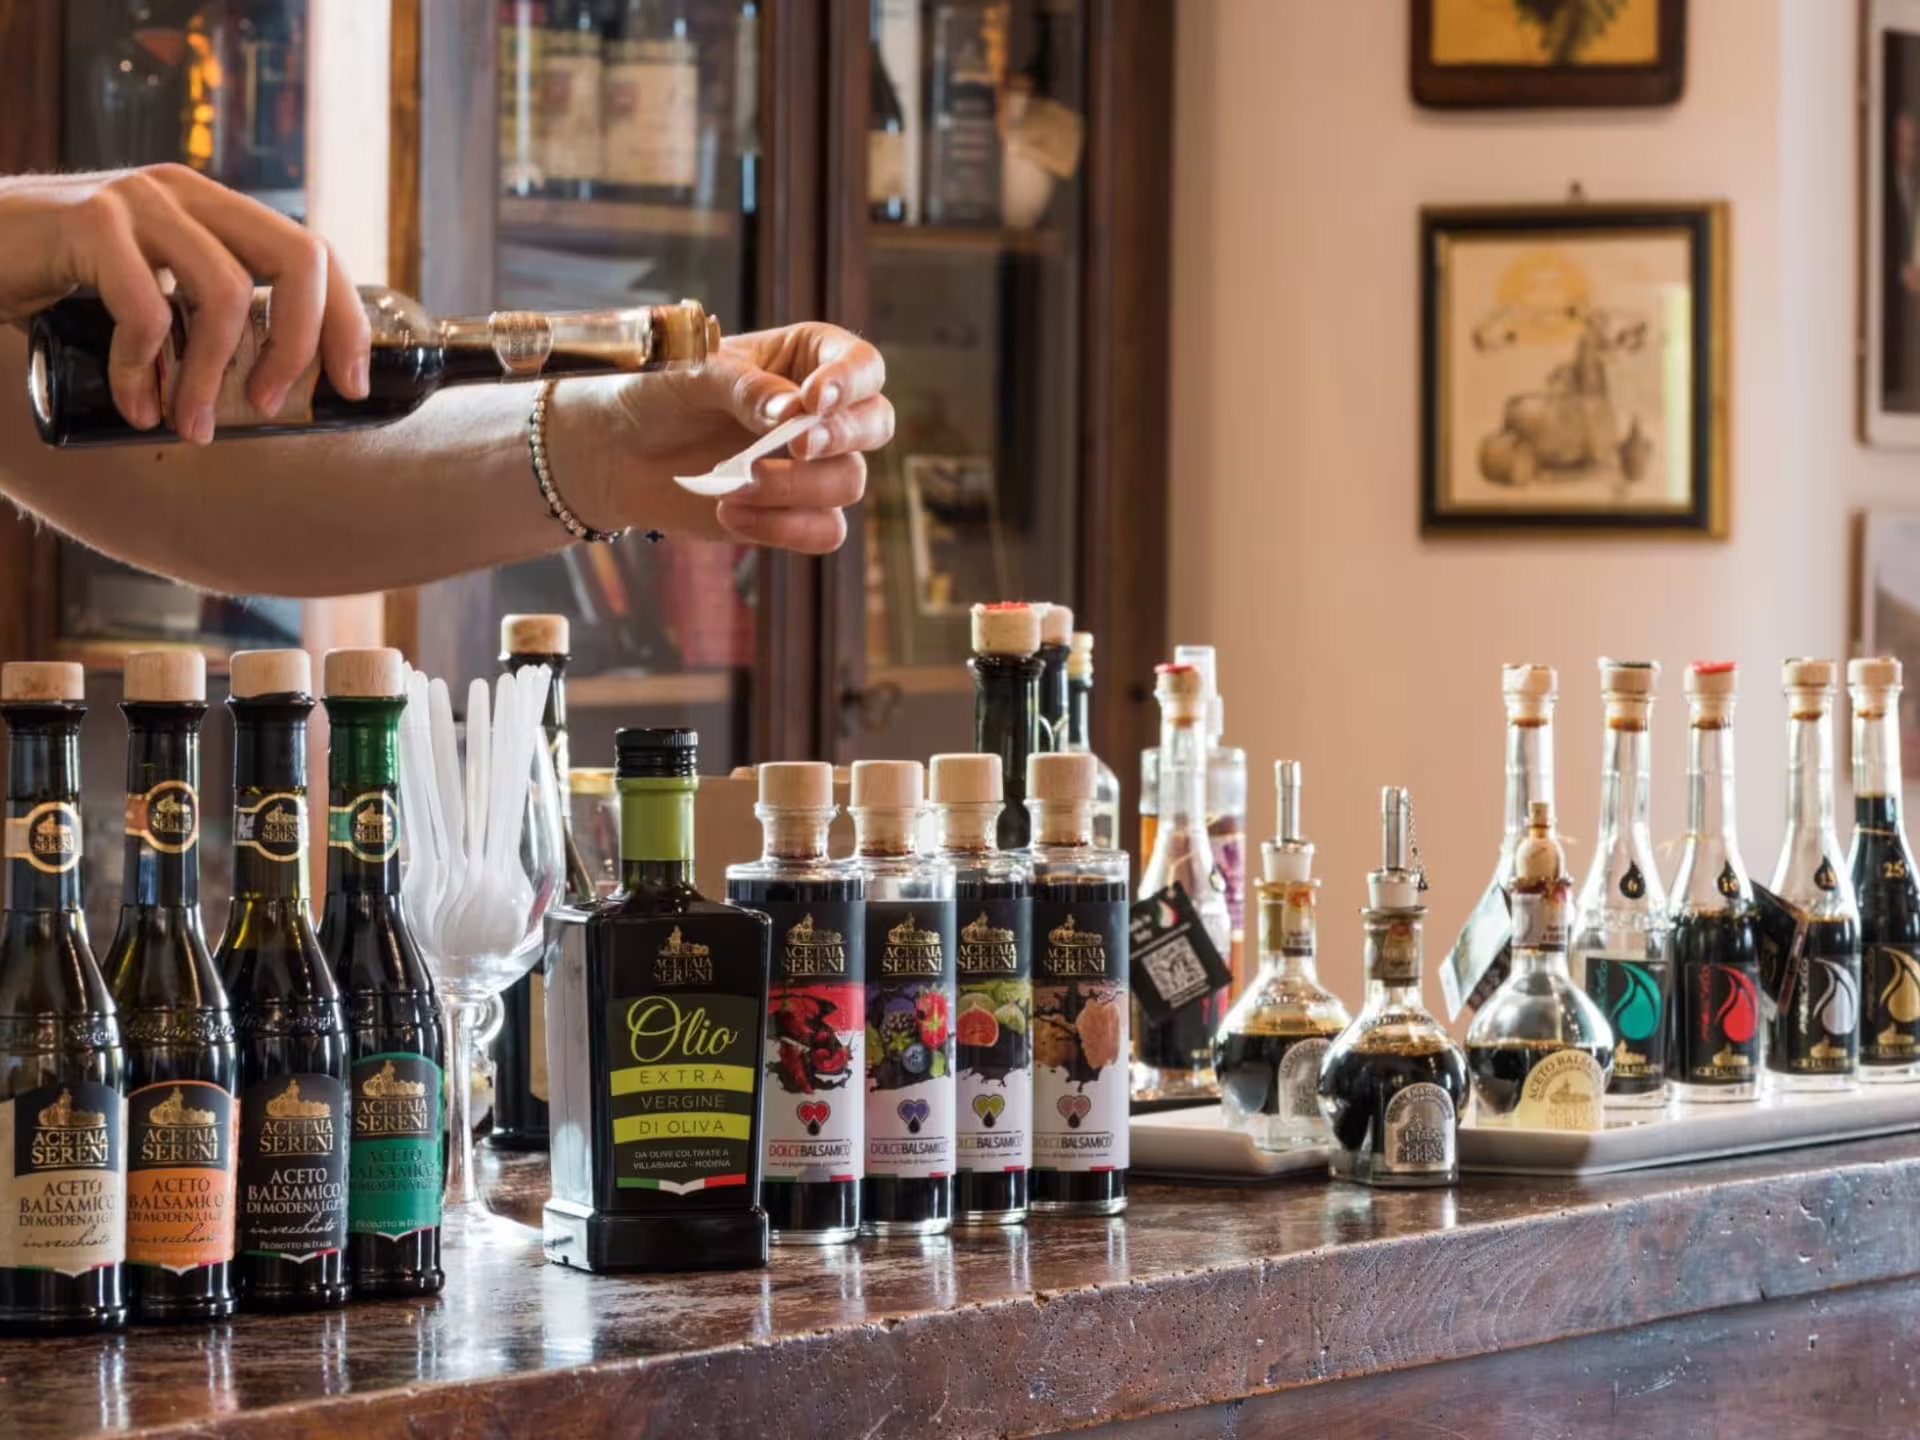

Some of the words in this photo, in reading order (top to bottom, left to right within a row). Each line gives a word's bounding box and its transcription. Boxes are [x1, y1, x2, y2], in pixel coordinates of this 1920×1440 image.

[1884, 863, 1905, 879] 25
[884, 945, 943, 958] ACETAIA
[960, 943, 1017, 957] ACETAIA
[783, 958, 845, 973] SERENI
[881, 958, 943, 973] SERENI
[957, 955, 1017, 970] SERENI
[1043, 958, 1106, 973] SERENI
[626, 995, 738, 1063] Olio
[639, 1068, 726, 1085] EXTRA
[1528, 1061, 1556, 1101] ACETO
[358, 1098, 428, 1114] ACETAIA
[641, 1094, 725, 1110] VERGINE
[261, 1119, 333, 1136] ACETAIA
[356, 1112, 429, 1131] SERENI
[639, 1120, 659, 1136] DI
[667, 1118, 725, 1136] OLIVA
[32, 1130, 108, 1146] ACETAIA
[144, 1128, 218, 1144] ACETAIA
[259, 1134, 334, 1153] SERENI
[31, 1144, 109, 1164] SERENI
[142, 1142, 218, 1161] SERENI
[650, 1149, 673, 1159] OLIVE
[675, 1148, 720, 1159] COLTIVATE
[769, 1143, 850, 1157] DOLCEBALSAMICO
[695, 1159, 731, 1169] MODENA
[270, 1166, 328, 1185] ACETO
[42, 1178, 102, 1196] ACETO
[152, 1177, 210, 1193] ACETO
[247, 1182, 341, 1200] BALSAMICO
[20, 1195, 116, 1214] BALSAMICO
[127, 1193, 224, 1211] BALSAMICO
[246, 1201, 261, 1214] DI
[263, 1200, 319, 1214] MODENA
[19, 1214, 34, 1227] DI
[35, 1213, 94, 1227] MODENA
[142, 1210, 202, 1223] MODENA
[249, 1211, 339, 1234] invecchiato
[20, 1224, 110, 1248] invecchiato
[259, 1240, 301, 1250] PRODOTTO
